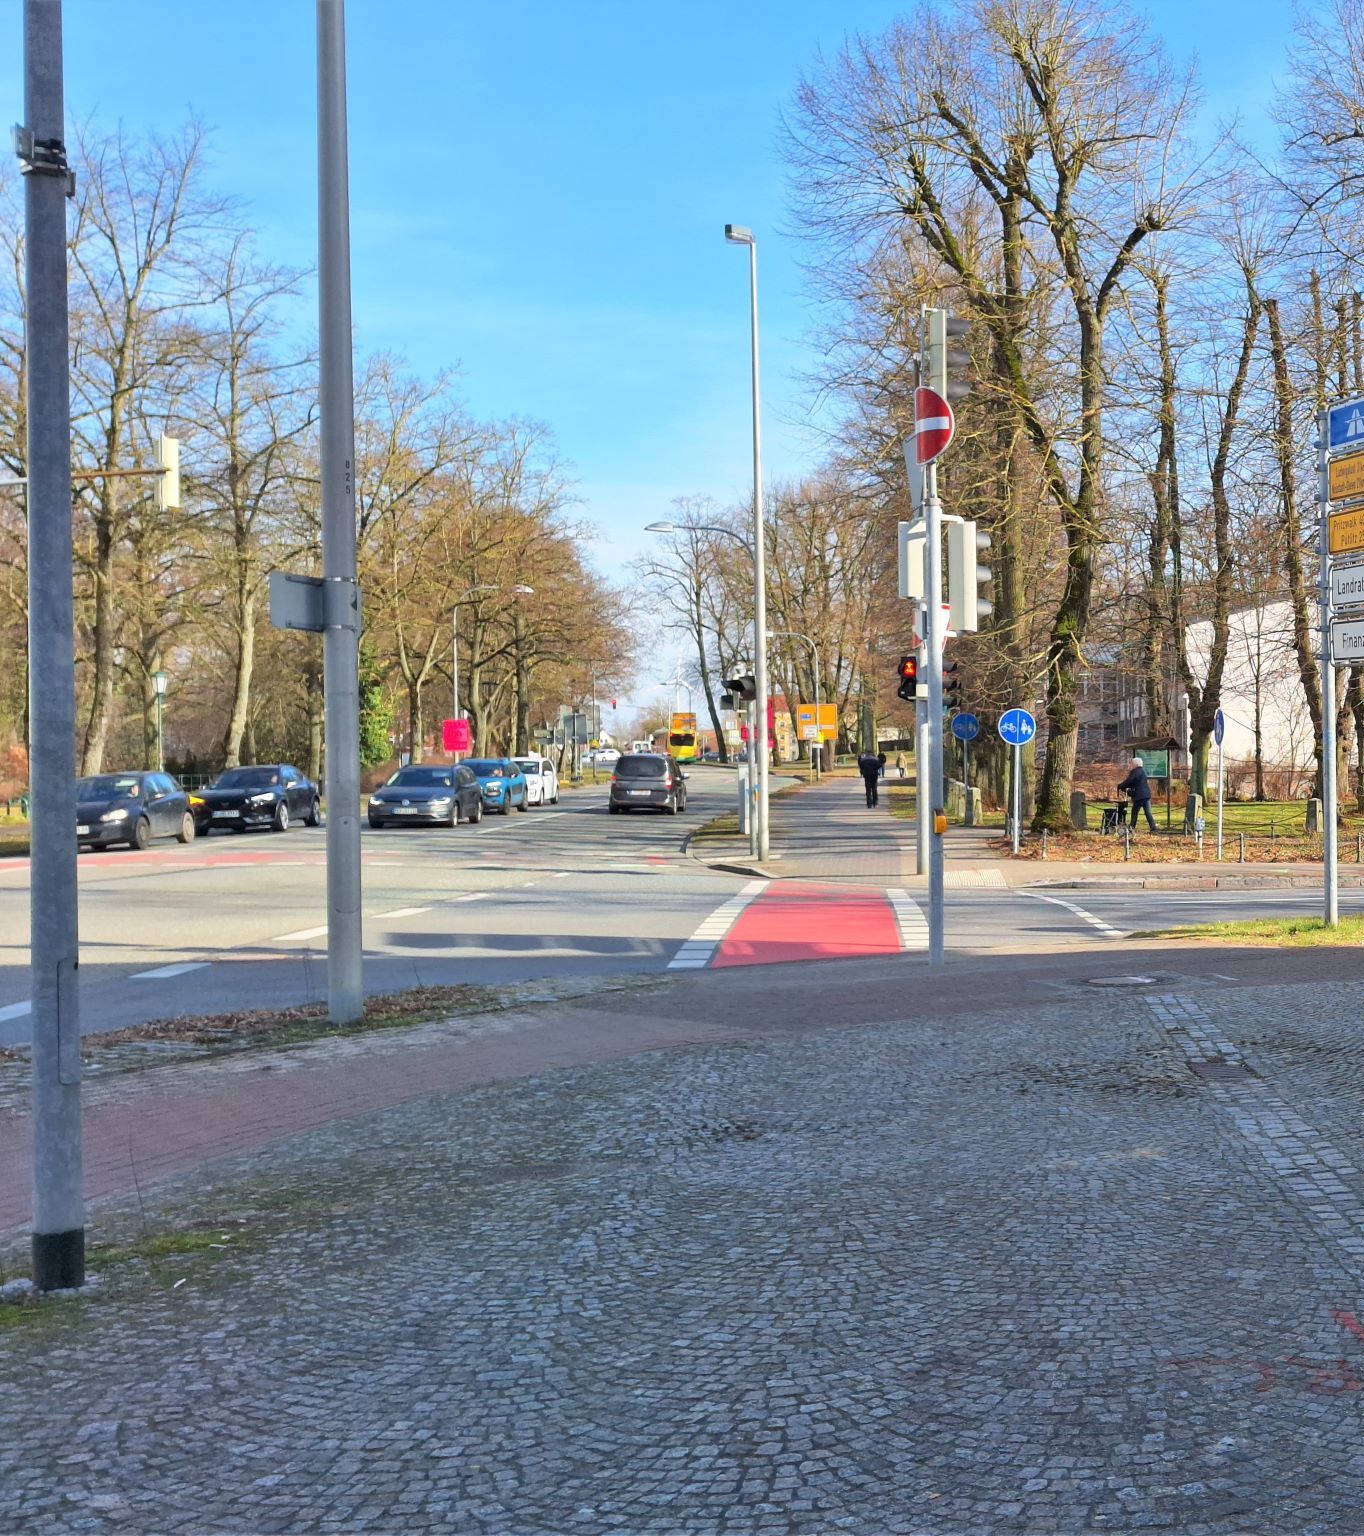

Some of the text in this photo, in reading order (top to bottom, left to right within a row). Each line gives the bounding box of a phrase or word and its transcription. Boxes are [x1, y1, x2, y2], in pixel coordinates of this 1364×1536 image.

[1334, 516, 1357, 530] Pritzwalk
[1341, 533, 1357, 544] Putlitz
[1359, 530, 1364, 541] 25
